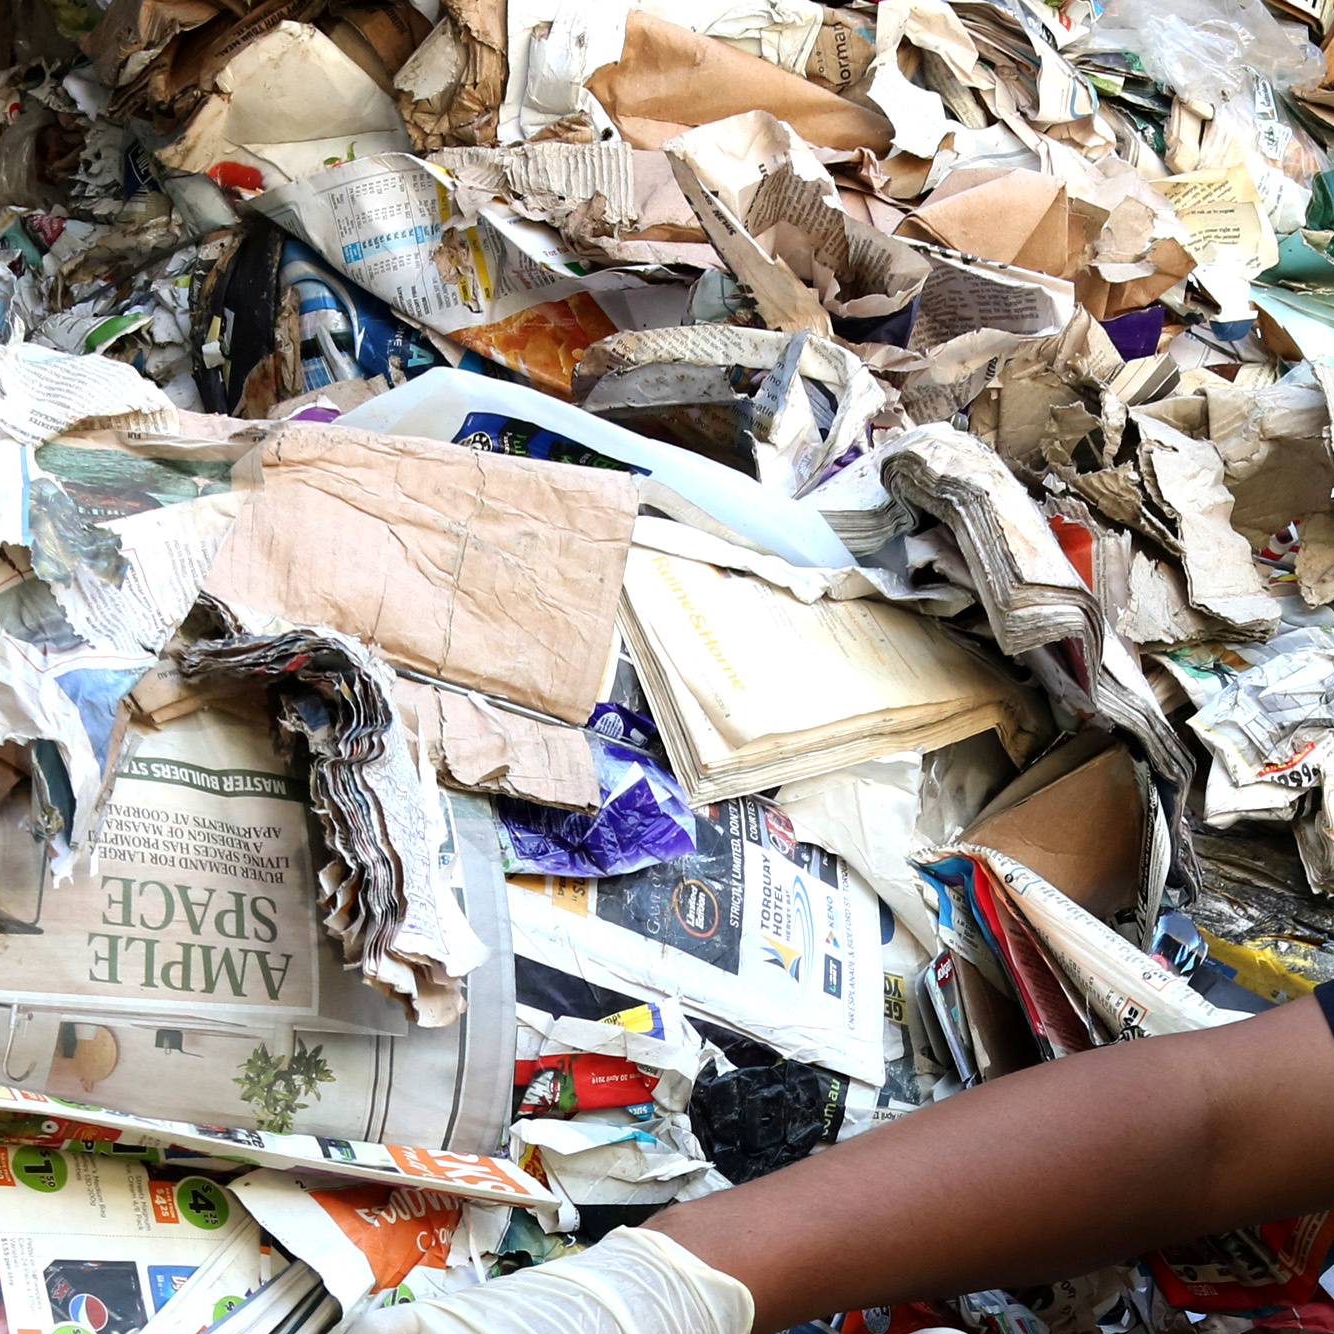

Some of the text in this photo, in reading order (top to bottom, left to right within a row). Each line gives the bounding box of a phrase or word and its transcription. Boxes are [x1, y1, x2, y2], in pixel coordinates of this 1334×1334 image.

[833, 20, 852, 88] orman
[153, 763, 287, 795] MASTER BUILDERS
[168, 827, 185, 840] OF
[173, 813, 283, 840] APARTMENTS AT
[190, 832, 251, 852] REDESIGN
[163, 841, 290, 869] LIVING SPACES HAS
[255, 842, 263, 853] A
[151, 855, 285, 884] BUYER DEMAND FOR
[101, 876, 278, 943] SPACE
[685, 885, 698, 927] Limited
[695, 892, 707, 930] Edition
[730, 882, 744, 928] STRICTLY
[760, 854, 773, 930] TORQUAY
[773, 884, 783, 938] HOTEL
[826, 896, 835, 930] KENO
[88, 932, 293, 1000] AMPLE
[847, 961, 861, 1012] ESPLANADE
